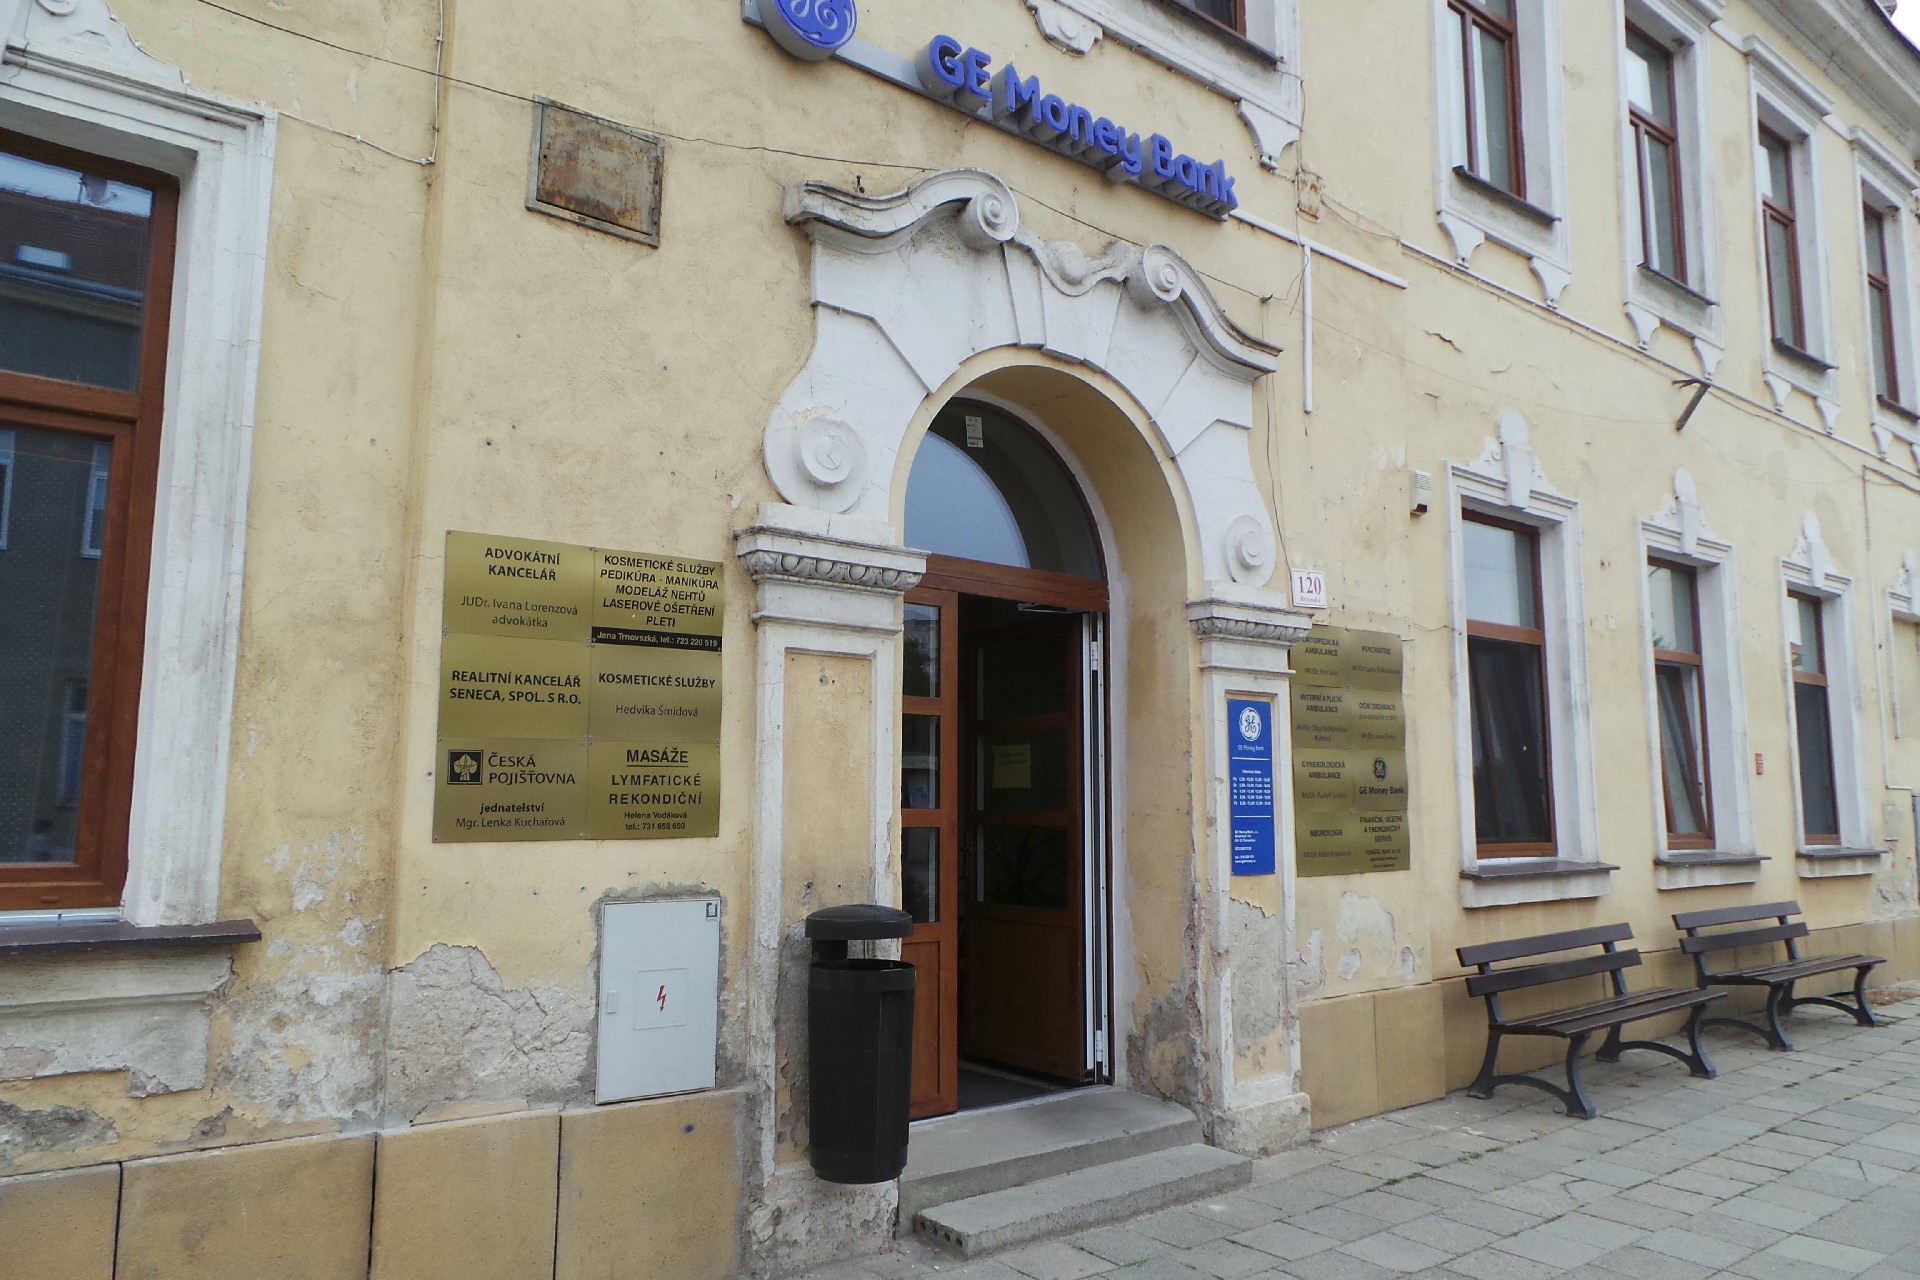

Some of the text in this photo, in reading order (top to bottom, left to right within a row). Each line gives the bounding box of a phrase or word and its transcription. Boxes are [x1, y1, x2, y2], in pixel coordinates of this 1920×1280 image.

[929, 34, 1238, 209] GE Money Bank
[485, 547, 561, 565] ADVOKÁTNÍ
[488, 564, 556, 580] KANCELÁŘ
[604, 555, 716, 576] KOSMETICKÉ SLUŽBY
[600, 569, 656, 582] PEDIKÚRA
[666, 576, 719, 590] MANIKÚRA
[1298, 576, 1322, 595] 120
[616, 584, 706, 602] MODELÁŽ NEHTŮ
[460, 596, 578, 615] JUDr. Ivana Lorenzová
[603, 598, 715, 616] LASEROVÉ OŠETŘENÍ
[492, 614, 548, 628] advokátka
[646, 616, 676, 627] PLETI
[597, 632, 616, 640] Jana
[660, 636, 674, 644] tel.:
[1305, 646, 1338, 656] AMBULANCE
[452, 670, 580, 688] REALITNÍ KANCELÁŘ
[598, 673, 716, 688] KOSMETICKÉ SLUŽBY
[450, 688, 582, 704] SENECA, SPOL. S R.O.
[616, 704, 656, 715] Hedvika
[1306, 704, 1338, 713] AMBULANCE
[488, 752, 536, 768] ČESKÁ
[626, 747, 688, 763] MASÁŽE
[490, 770, 576, 785] POJIŠŤOVNA
[612, 773, 701, 786] LYMFATICKÉ
[609, 792, 702, 804] REKONDIČNÍ
[1369, 787, 1388, 796] Money
[480, 802, 544, 815] jednatelství
[456, 818, 478, 829] Mgr.
[482, 818, 512, 828] Lenka
